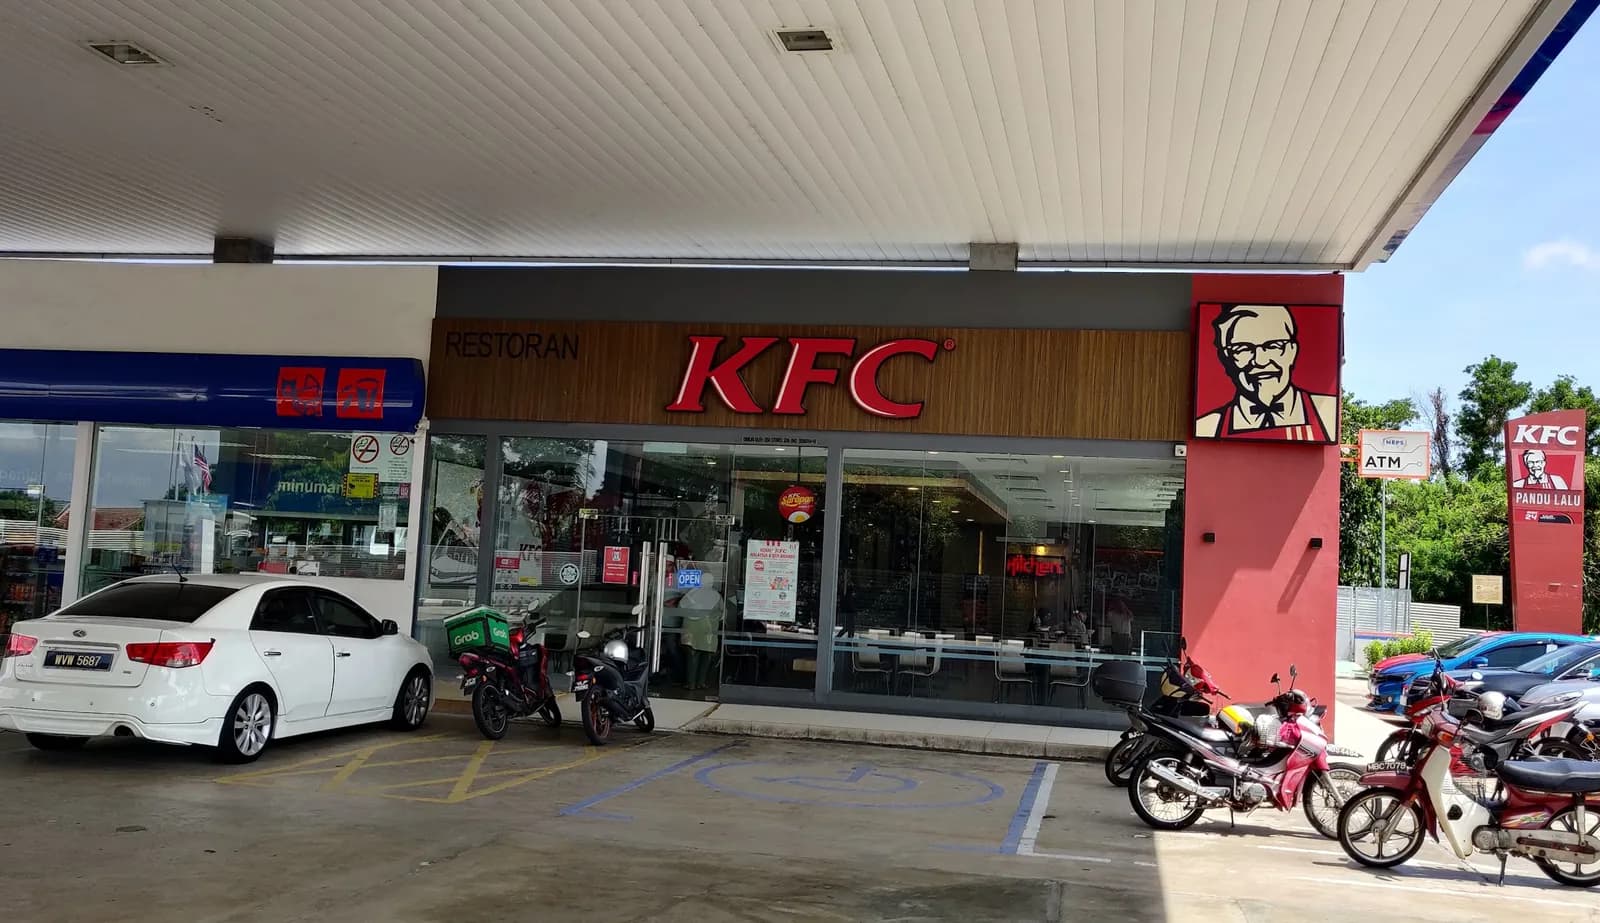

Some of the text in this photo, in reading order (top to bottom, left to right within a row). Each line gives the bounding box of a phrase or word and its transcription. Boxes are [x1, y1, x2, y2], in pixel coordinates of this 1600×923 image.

[446, 331, 579, 360] RESTORAN
[665, 335, 939, 419] KFC
[1512, 425, 1580, 446] KFC
[1365, 455, 1401, 469] ATM
[1516, 492, 1581, 506] PANDU LALU
[679, 574, 701, 585] OPEN
[454, 630, 480, 646] Grab
[54, 654, 102, 667] WVW 5687
